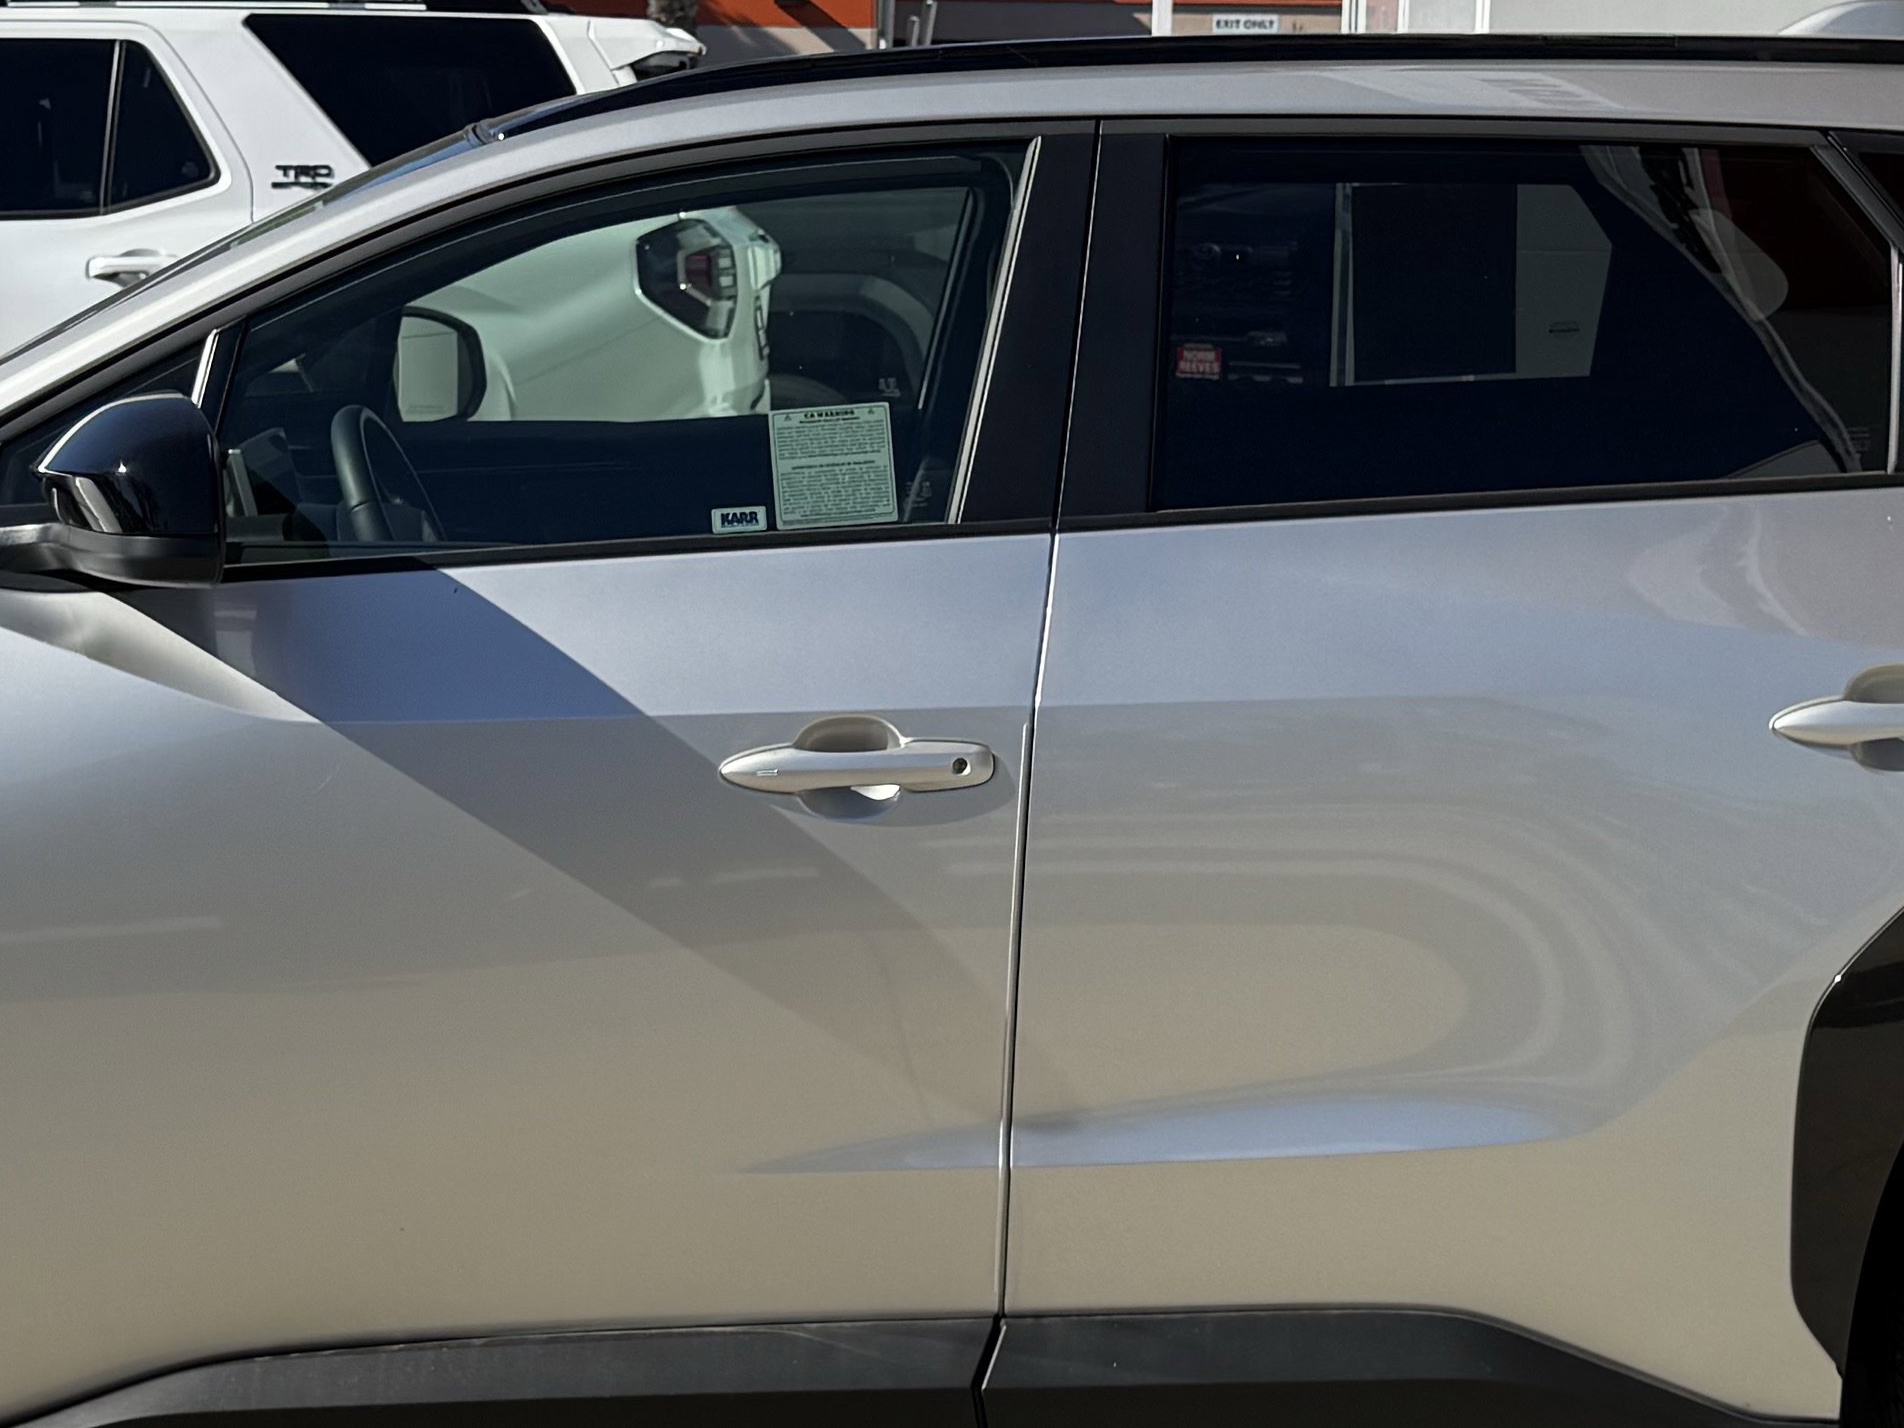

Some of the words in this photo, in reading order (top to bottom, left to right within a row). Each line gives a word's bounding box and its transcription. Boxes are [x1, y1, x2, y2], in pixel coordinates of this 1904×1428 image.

[1216, 19, 1240, 29] EXIT
[1243, 19, 1274, 30] ONLY
[275, 164, 335, 180] TRD
[720, 511, 759, 526] KARR
